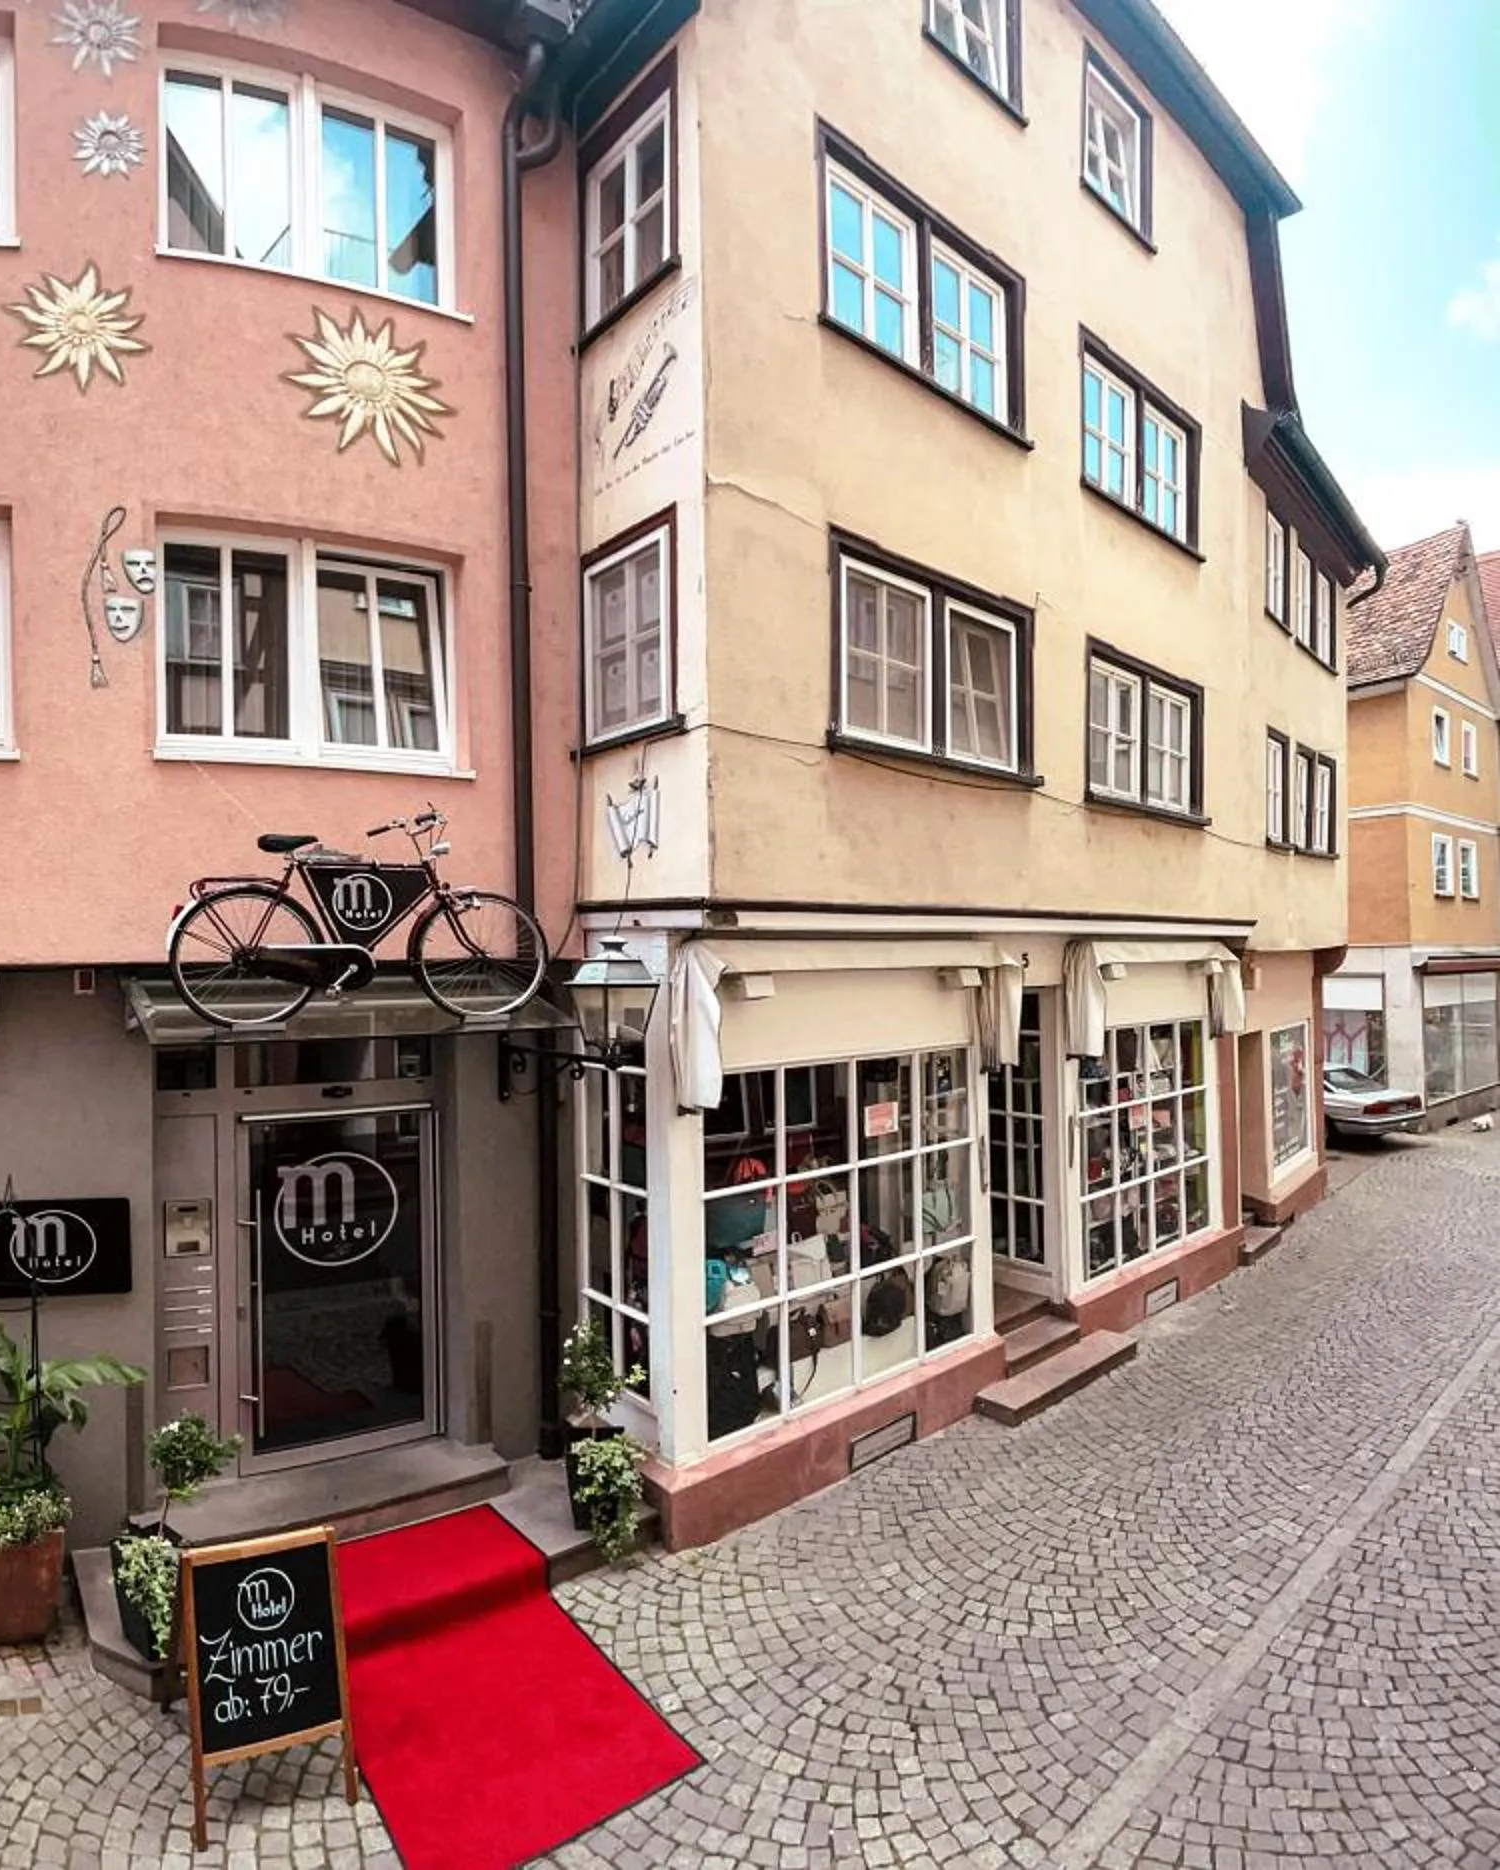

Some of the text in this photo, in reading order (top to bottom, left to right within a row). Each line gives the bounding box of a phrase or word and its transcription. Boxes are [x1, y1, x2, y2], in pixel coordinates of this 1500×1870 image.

[345, 909, 382, 919] Hotel
[1022, 953, 1029, 968] 5
[277, 1162, 355, 1229] m
[302, 1220, 375, 1244] Hotel
[29, 1255, 81, 1269] Hotel
[252, 1596, 287, 1620] Hotel
[199, 1627, 323, 1684] Zimmer
[214, 1684, 253, 1723] ab:
